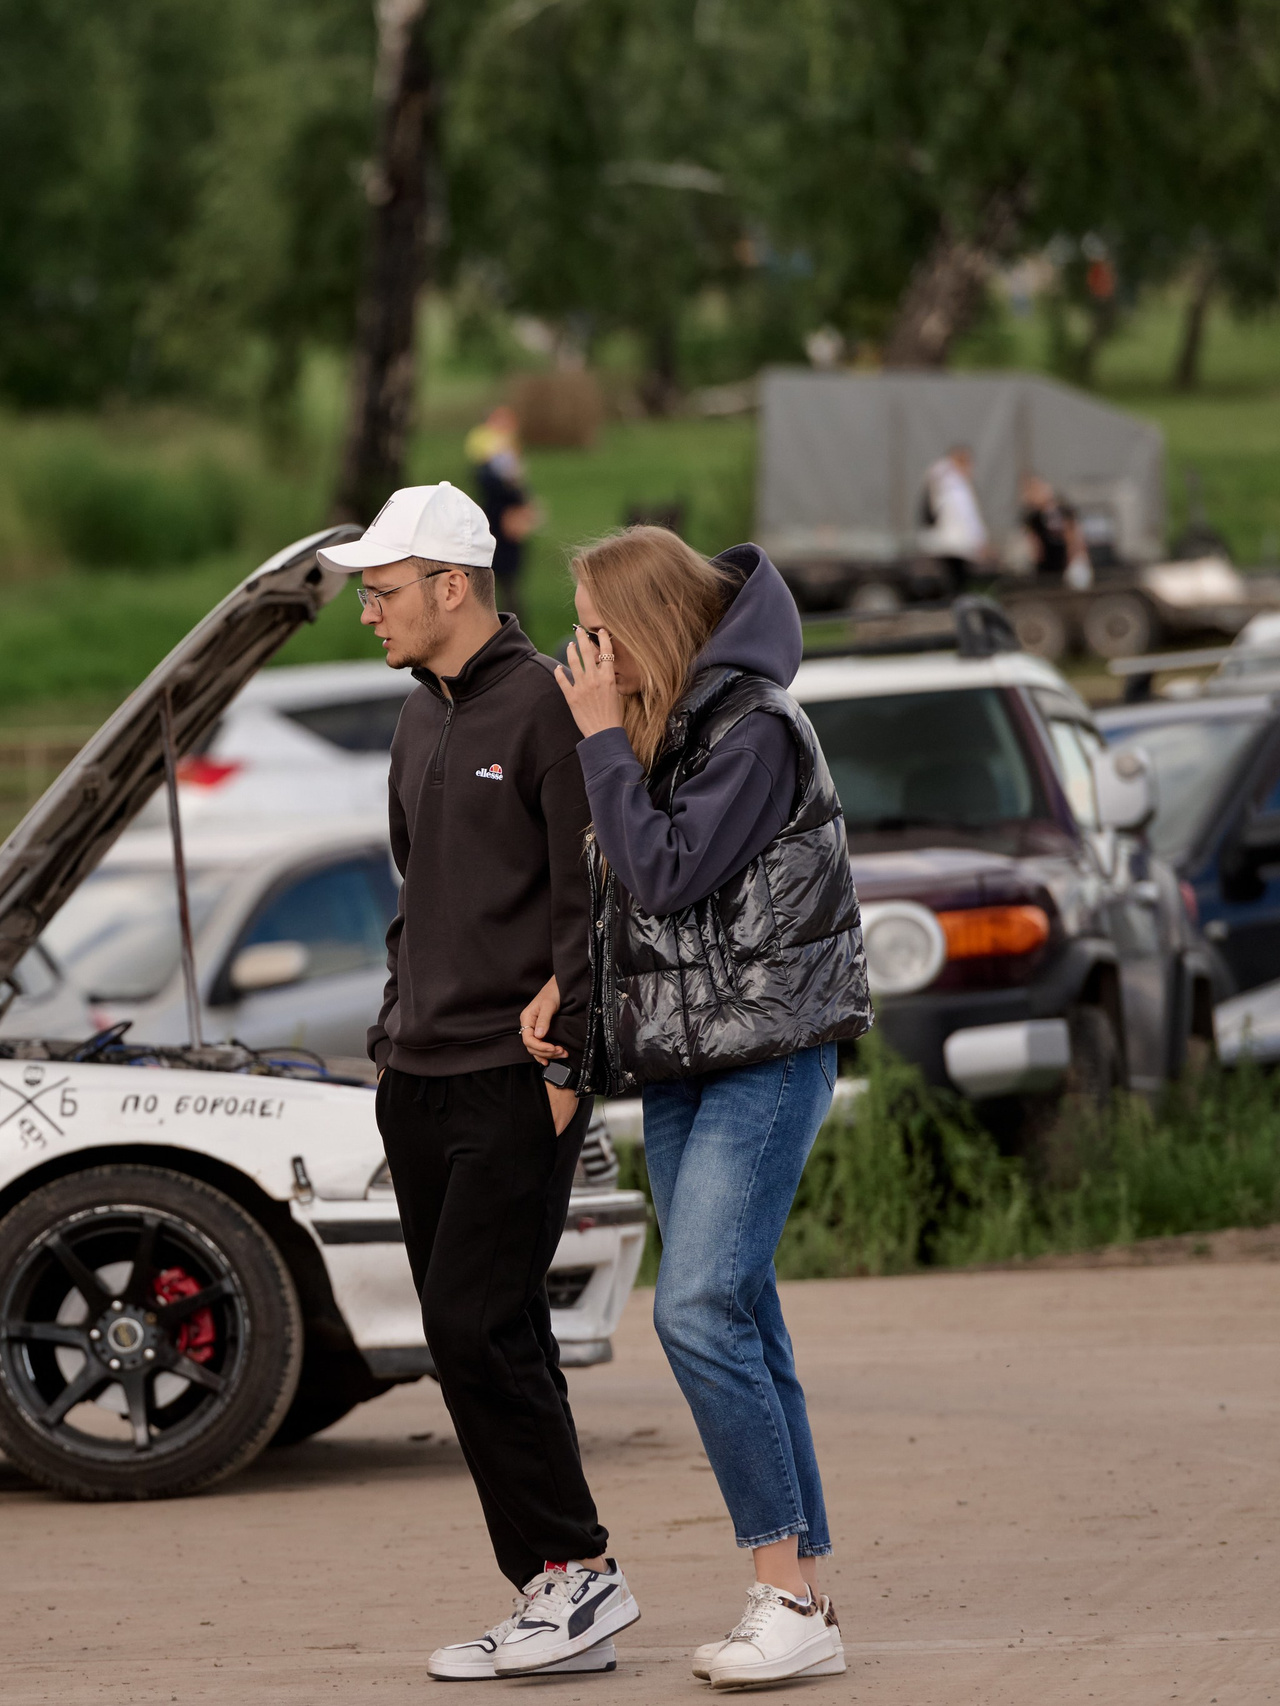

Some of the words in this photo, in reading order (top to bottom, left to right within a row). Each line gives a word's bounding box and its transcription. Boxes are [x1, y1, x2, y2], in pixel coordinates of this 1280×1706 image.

[475, 767, 504, 781] ellesse
[60, 1087, 78, 1118] Б
[121, 1094, 160, 1114] ПО
